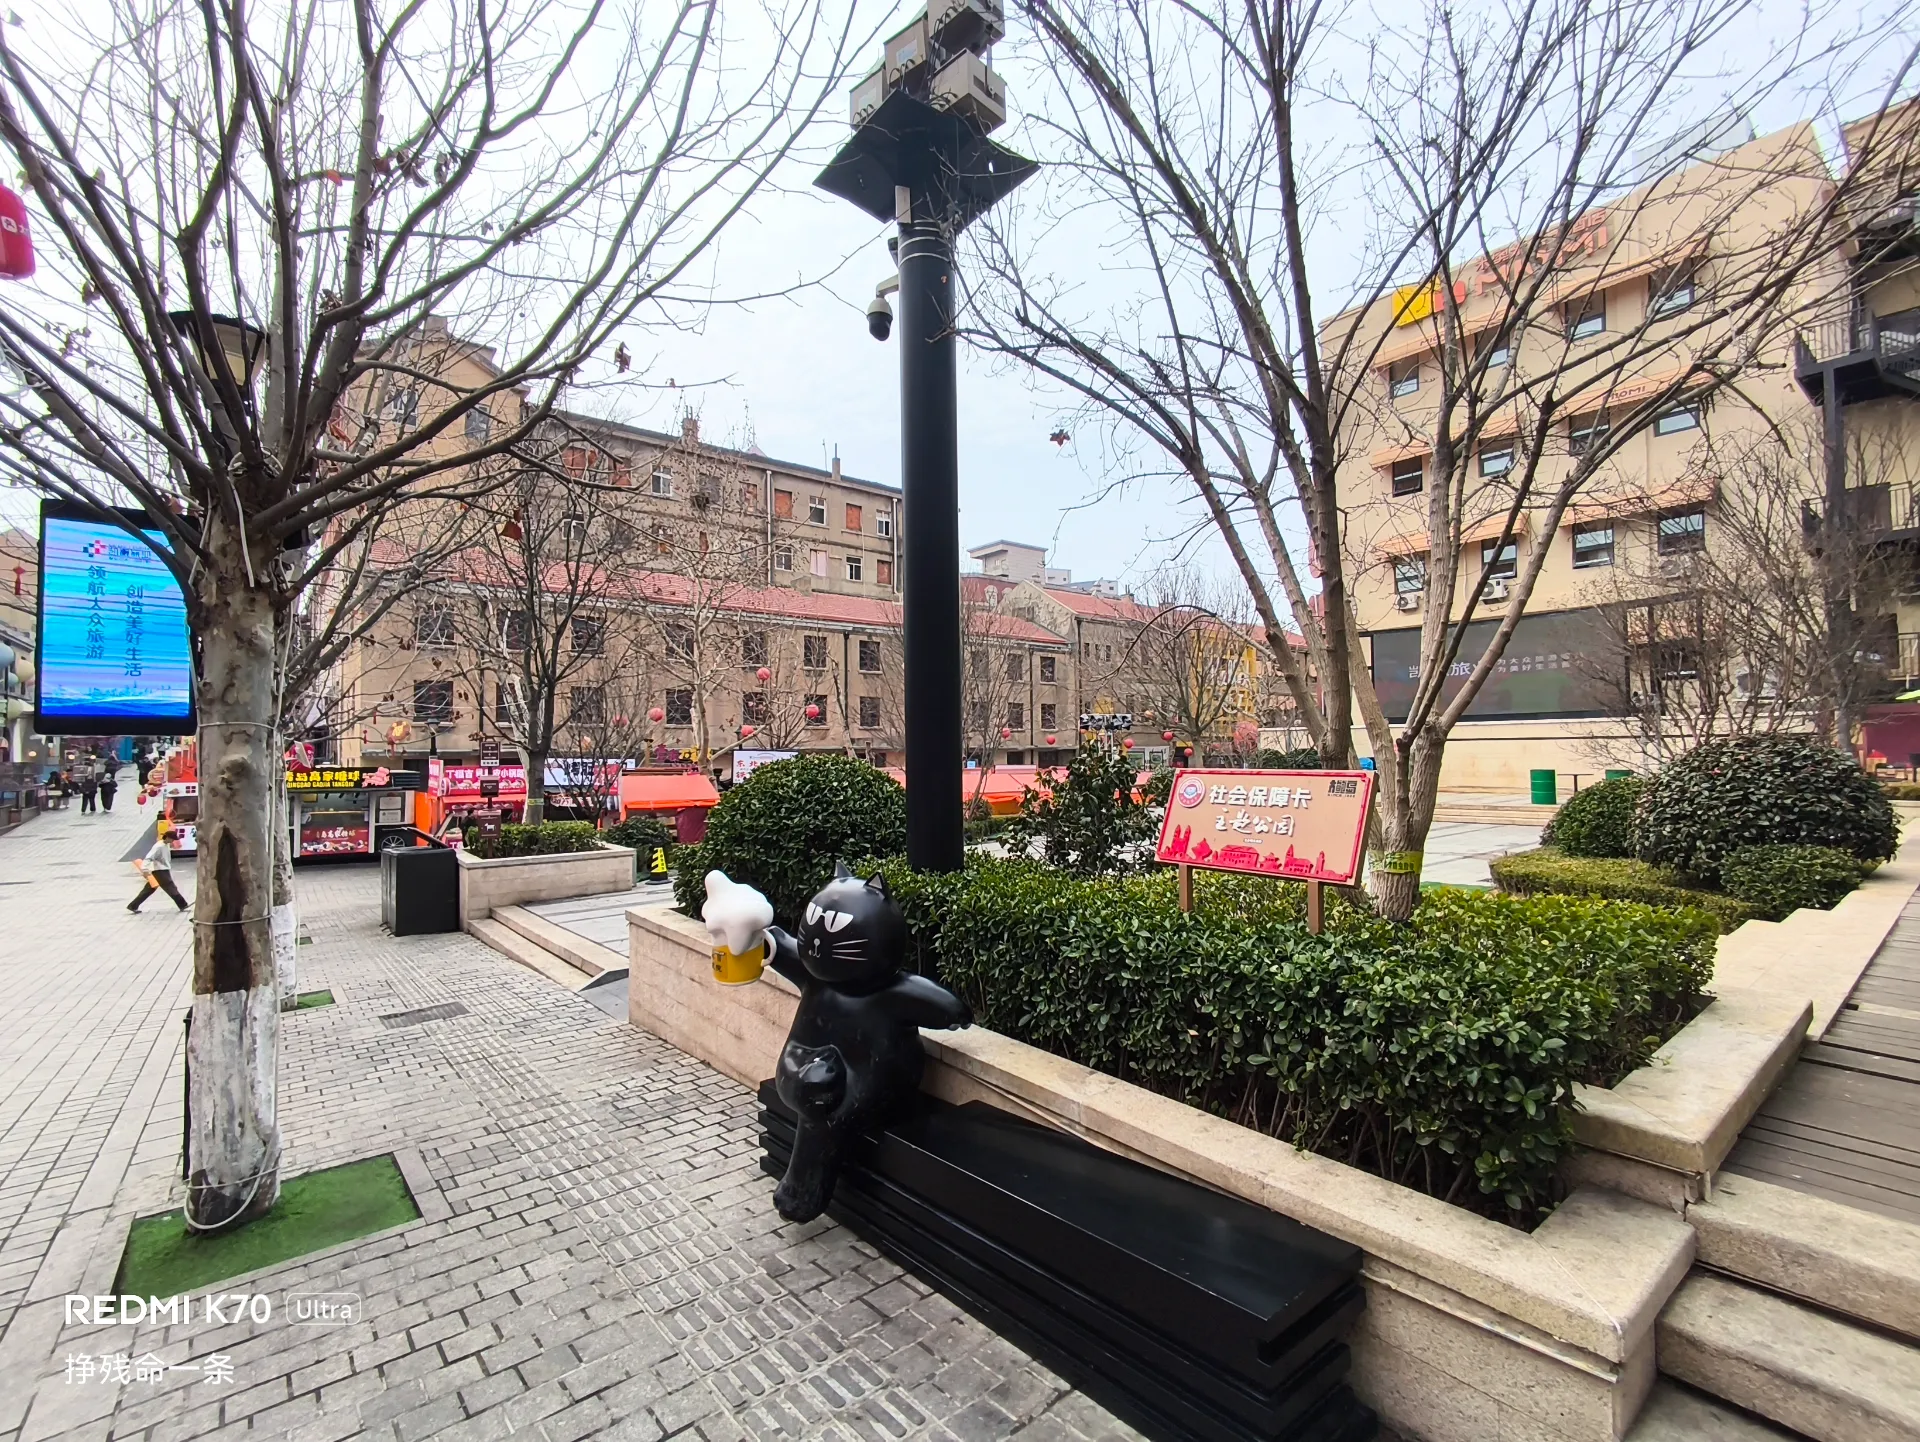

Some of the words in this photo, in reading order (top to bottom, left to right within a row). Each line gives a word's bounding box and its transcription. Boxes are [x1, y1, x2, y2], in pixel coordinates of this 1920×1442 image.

[86, 564, 108, 660] 领航大众旅游
[124, 583, 144, 677] 创造美好生活
[1209, 784, 1312, 809] 社会保障卡
[1214, 807, 1296, 837] 主题公园
